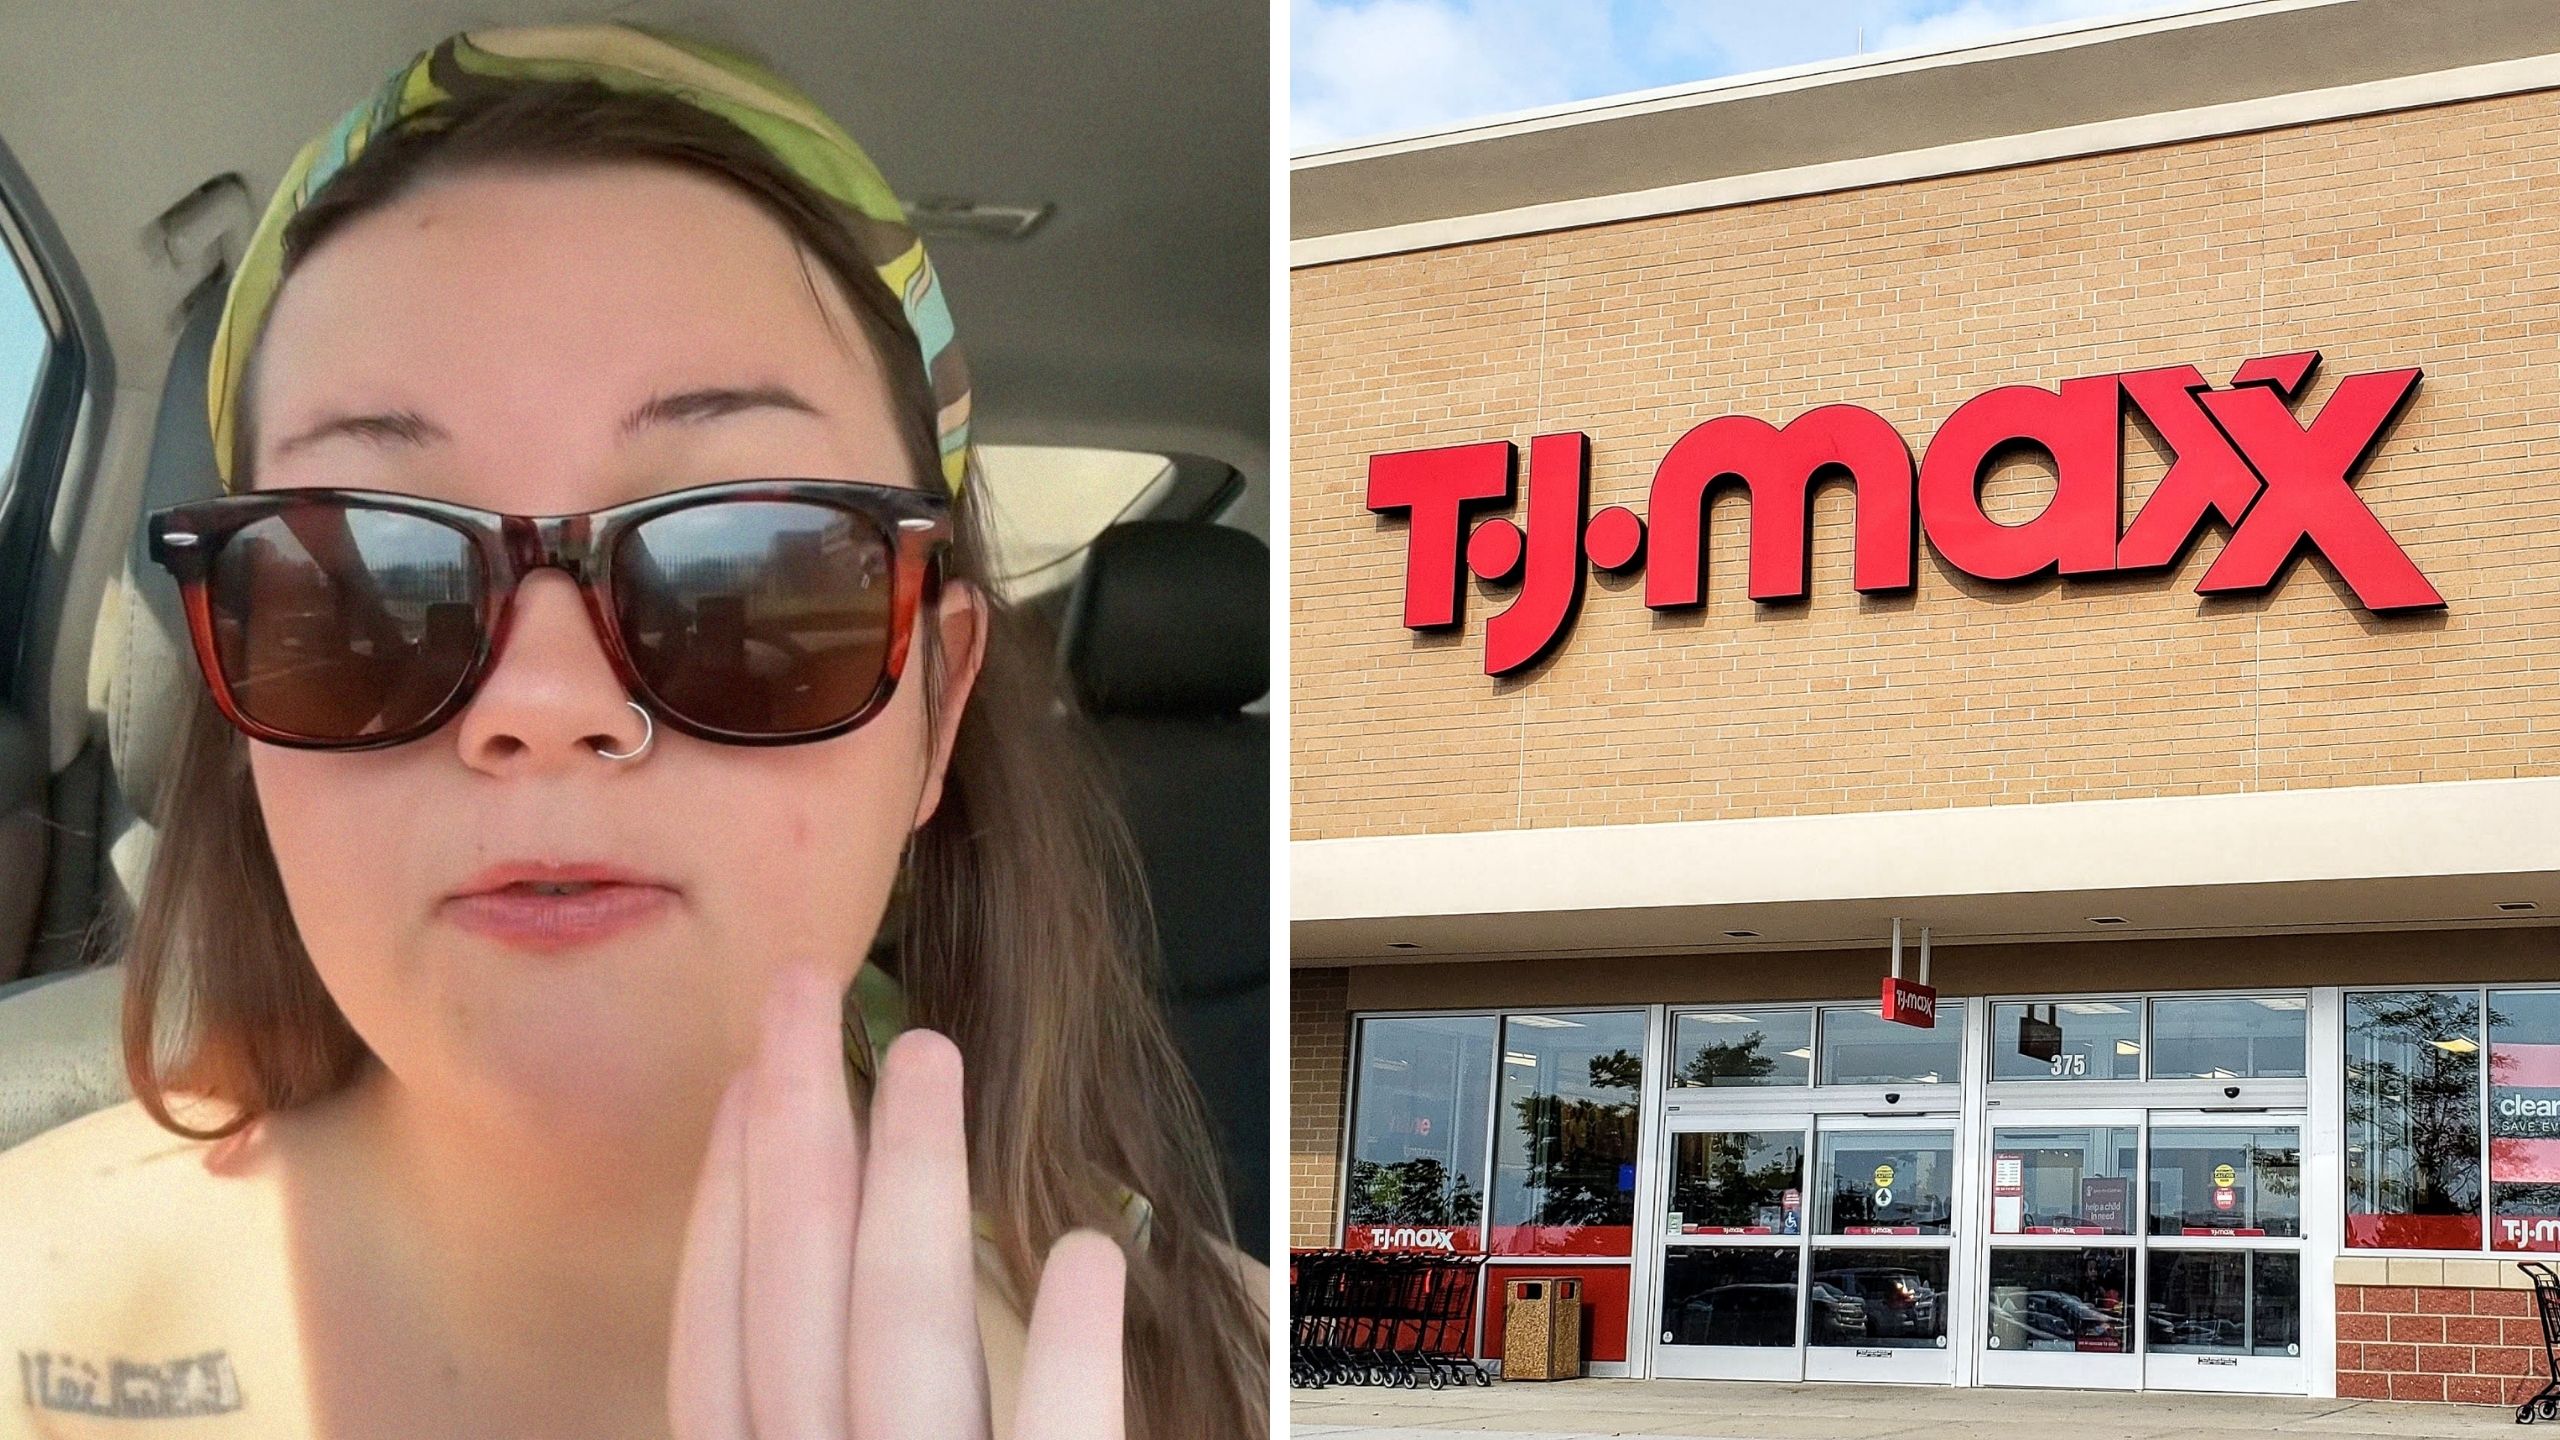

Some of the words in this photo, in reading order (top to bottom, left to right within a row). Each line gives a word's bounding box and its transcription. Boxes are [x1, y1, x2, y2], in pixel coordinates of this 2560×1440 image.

[2050, 1054, 2086, 1076] 375
[2501, 1121, 2536, 1131] SAVE
[2085, 1202, 2100, 1212] help
[2105, 1201, 2121, 1211] child
[2097, 1210, 2115, 1220] need
